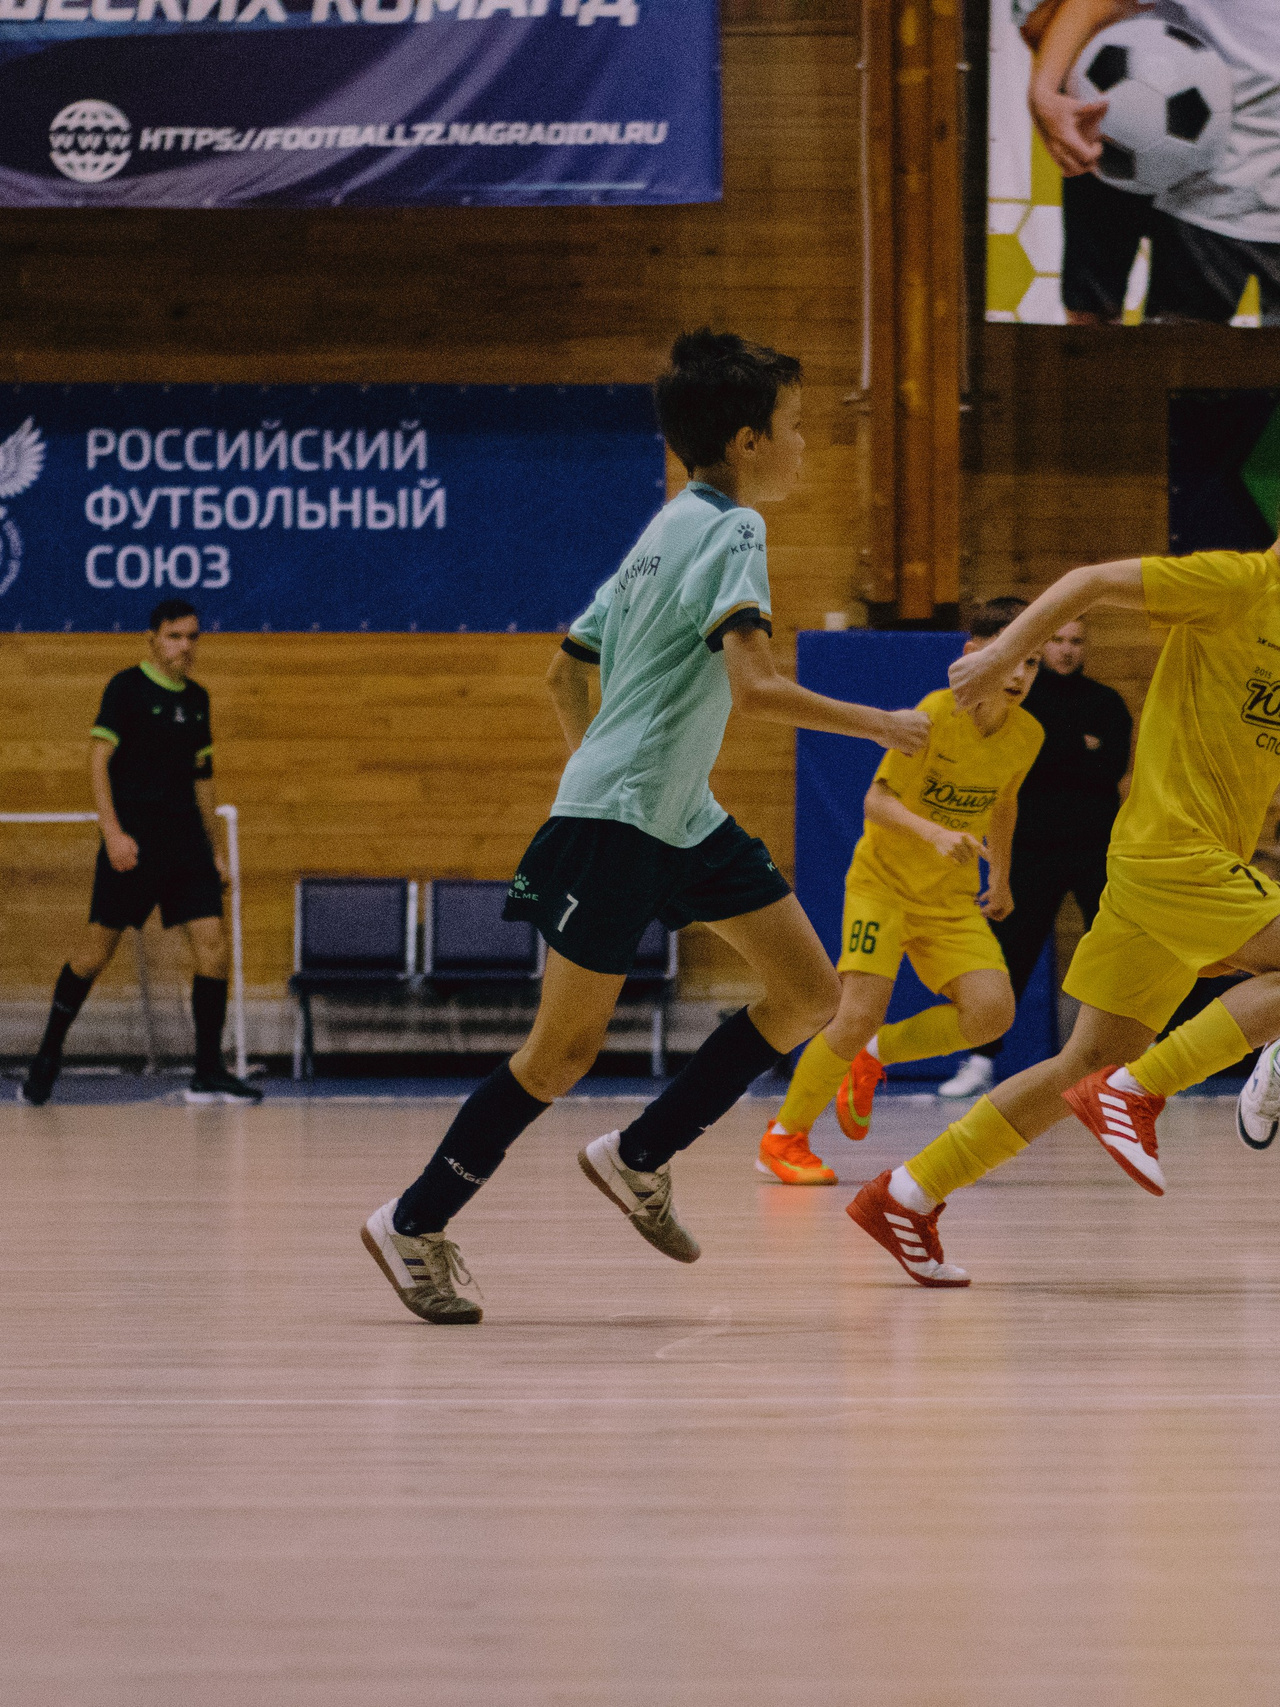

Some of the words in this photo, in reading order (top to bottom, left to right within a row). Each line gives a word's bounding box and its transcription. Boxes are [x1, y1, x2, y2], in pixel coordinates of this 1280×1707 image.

[86, 418, 428, 472] РОССИЙСКИЙ
[85, 477, 447, 530] ФУТБОЛЬНЫЙ
[85, 545, 231, 589] СОЮЗ
[930, 810, 970, 829] СПОР
[507, 888, 540, 902] ELME
[556, 893, 580, 933] 7
[849, 919, 880, 955] 86
